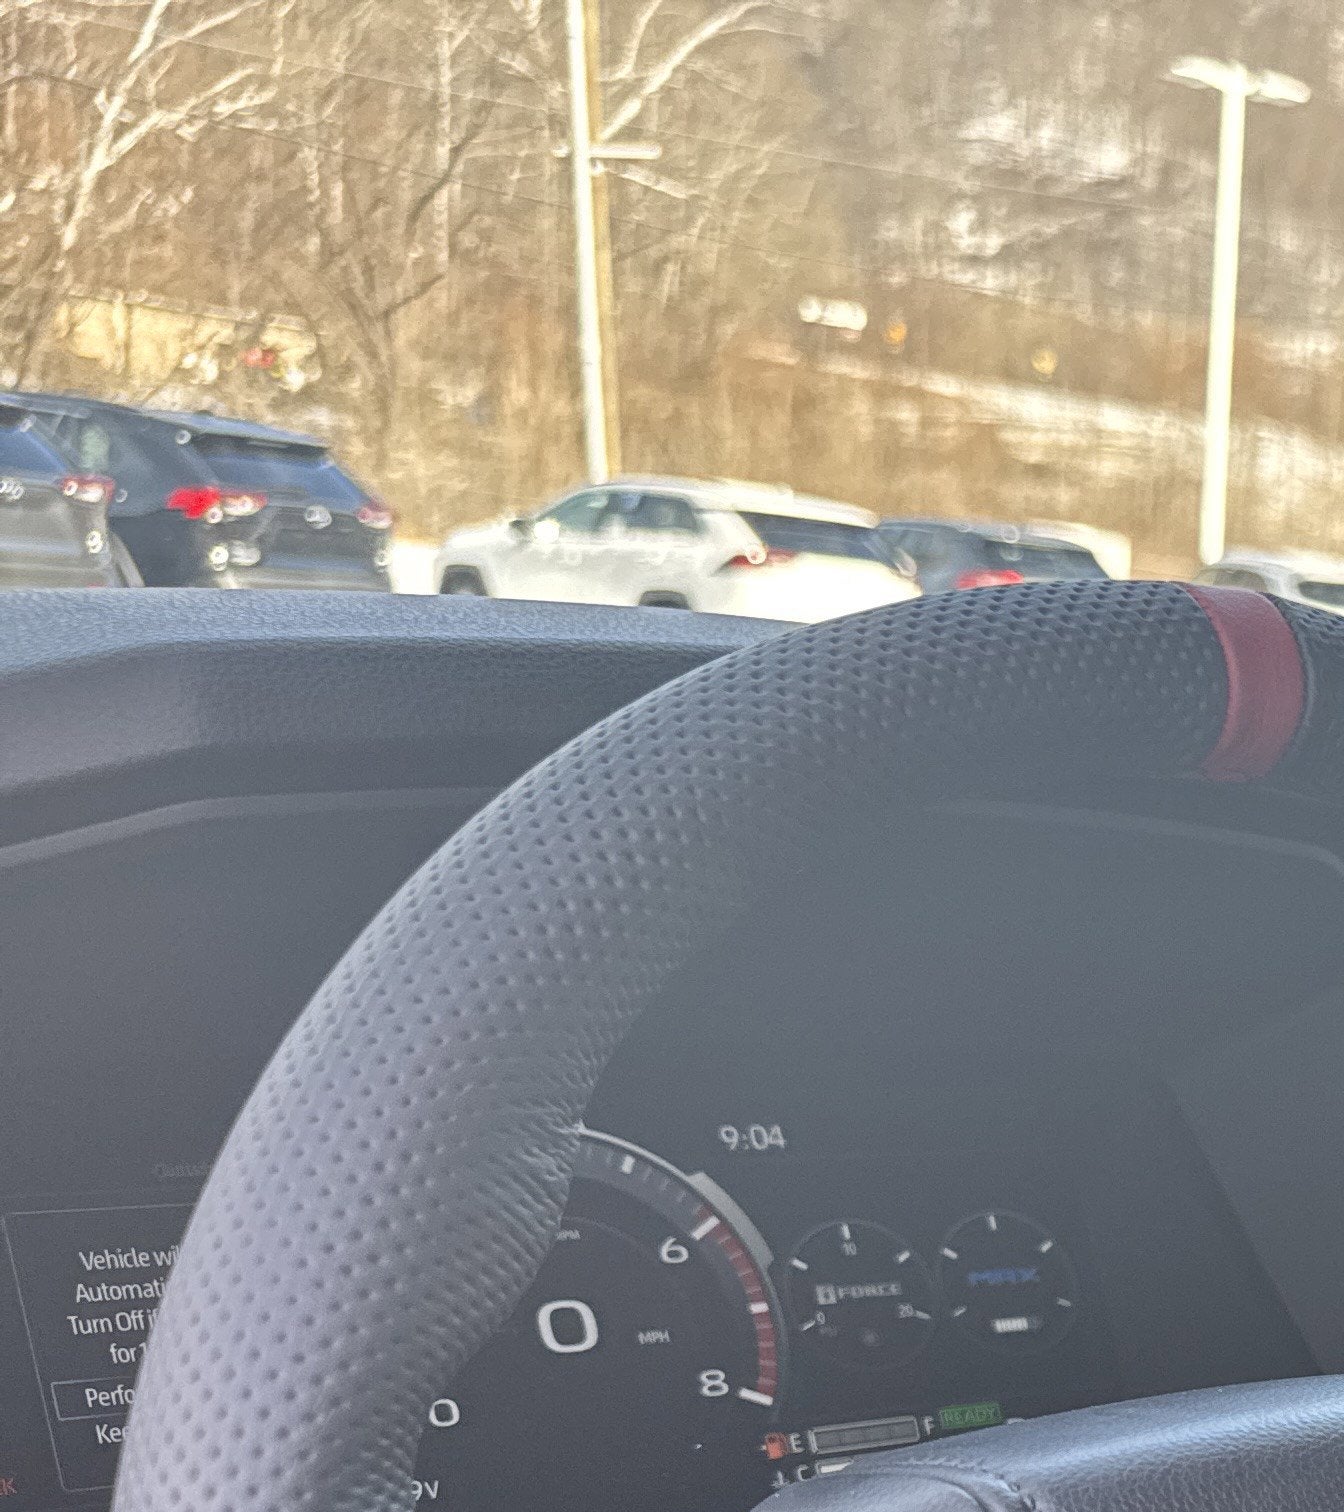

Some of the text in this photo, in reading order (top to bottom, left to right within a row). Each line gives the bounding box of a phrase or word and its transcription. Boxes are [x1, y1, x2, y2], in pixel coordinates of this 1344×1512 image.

[718, 1124, 786, 1150] 9:04
[78, 1244, 180, 1271] Vehicle wil
[660, 1236, 689, 1264] 6
[75, 1277, 166, 1303] Automati
[67, 1315, 113, 1336] Turn
[115, 1311, 146, 1333] Off
[536, 1299, 599, 1353] 0
[638, 1328, 671, 1345] MPH
[110, 1343, 136, 1365] for
[699, 1368, 729, 1397] 8
[85, 1385, 135, 1408] Perfo
[429, 1398, 460, 1427] 0
[945, 1407, 996, 1427] READY
[95, 1423, 128, 1444] Kee
[924, 1416, 934, 1437] F
[789, 1432, 804, 1454] E
